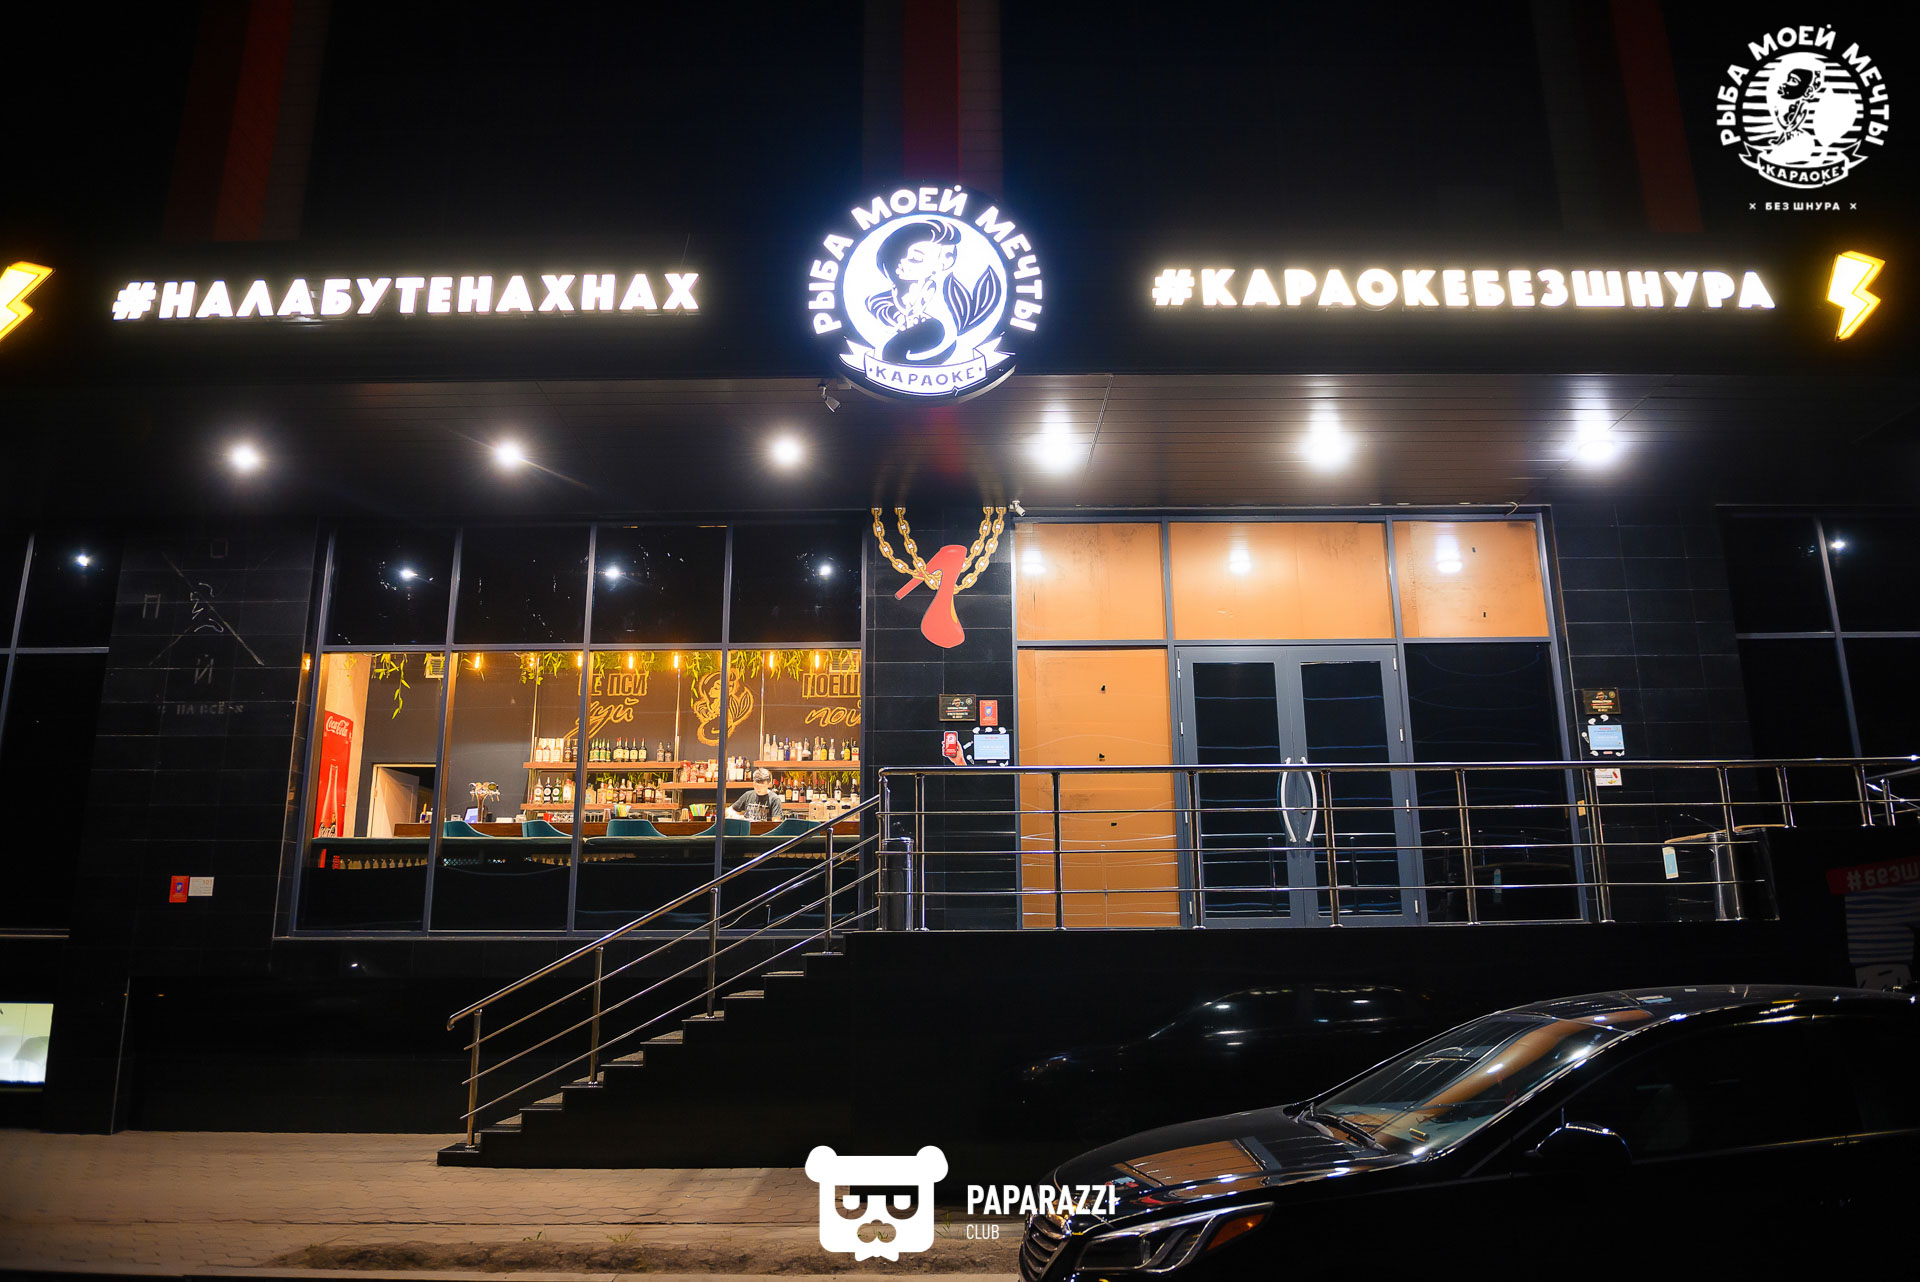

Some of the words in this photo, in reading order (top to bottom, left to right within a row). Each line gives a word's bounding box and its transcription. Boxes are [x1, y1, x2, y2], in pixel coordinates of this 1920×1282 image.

[808, 234, 854, 334] РЫБА
[851, 184, 968, 230] МОЕЙ
[975, 205, 1043, 332] МЕЧТЫ
[112, 273, 699, 320] #НАЛАБУТЕНАХНАХ
[1151, 268, 1776, 309] #КАРАОКЕБЕЗШНУРА
[875, 365, 976, 386] КАРАОКЕ
